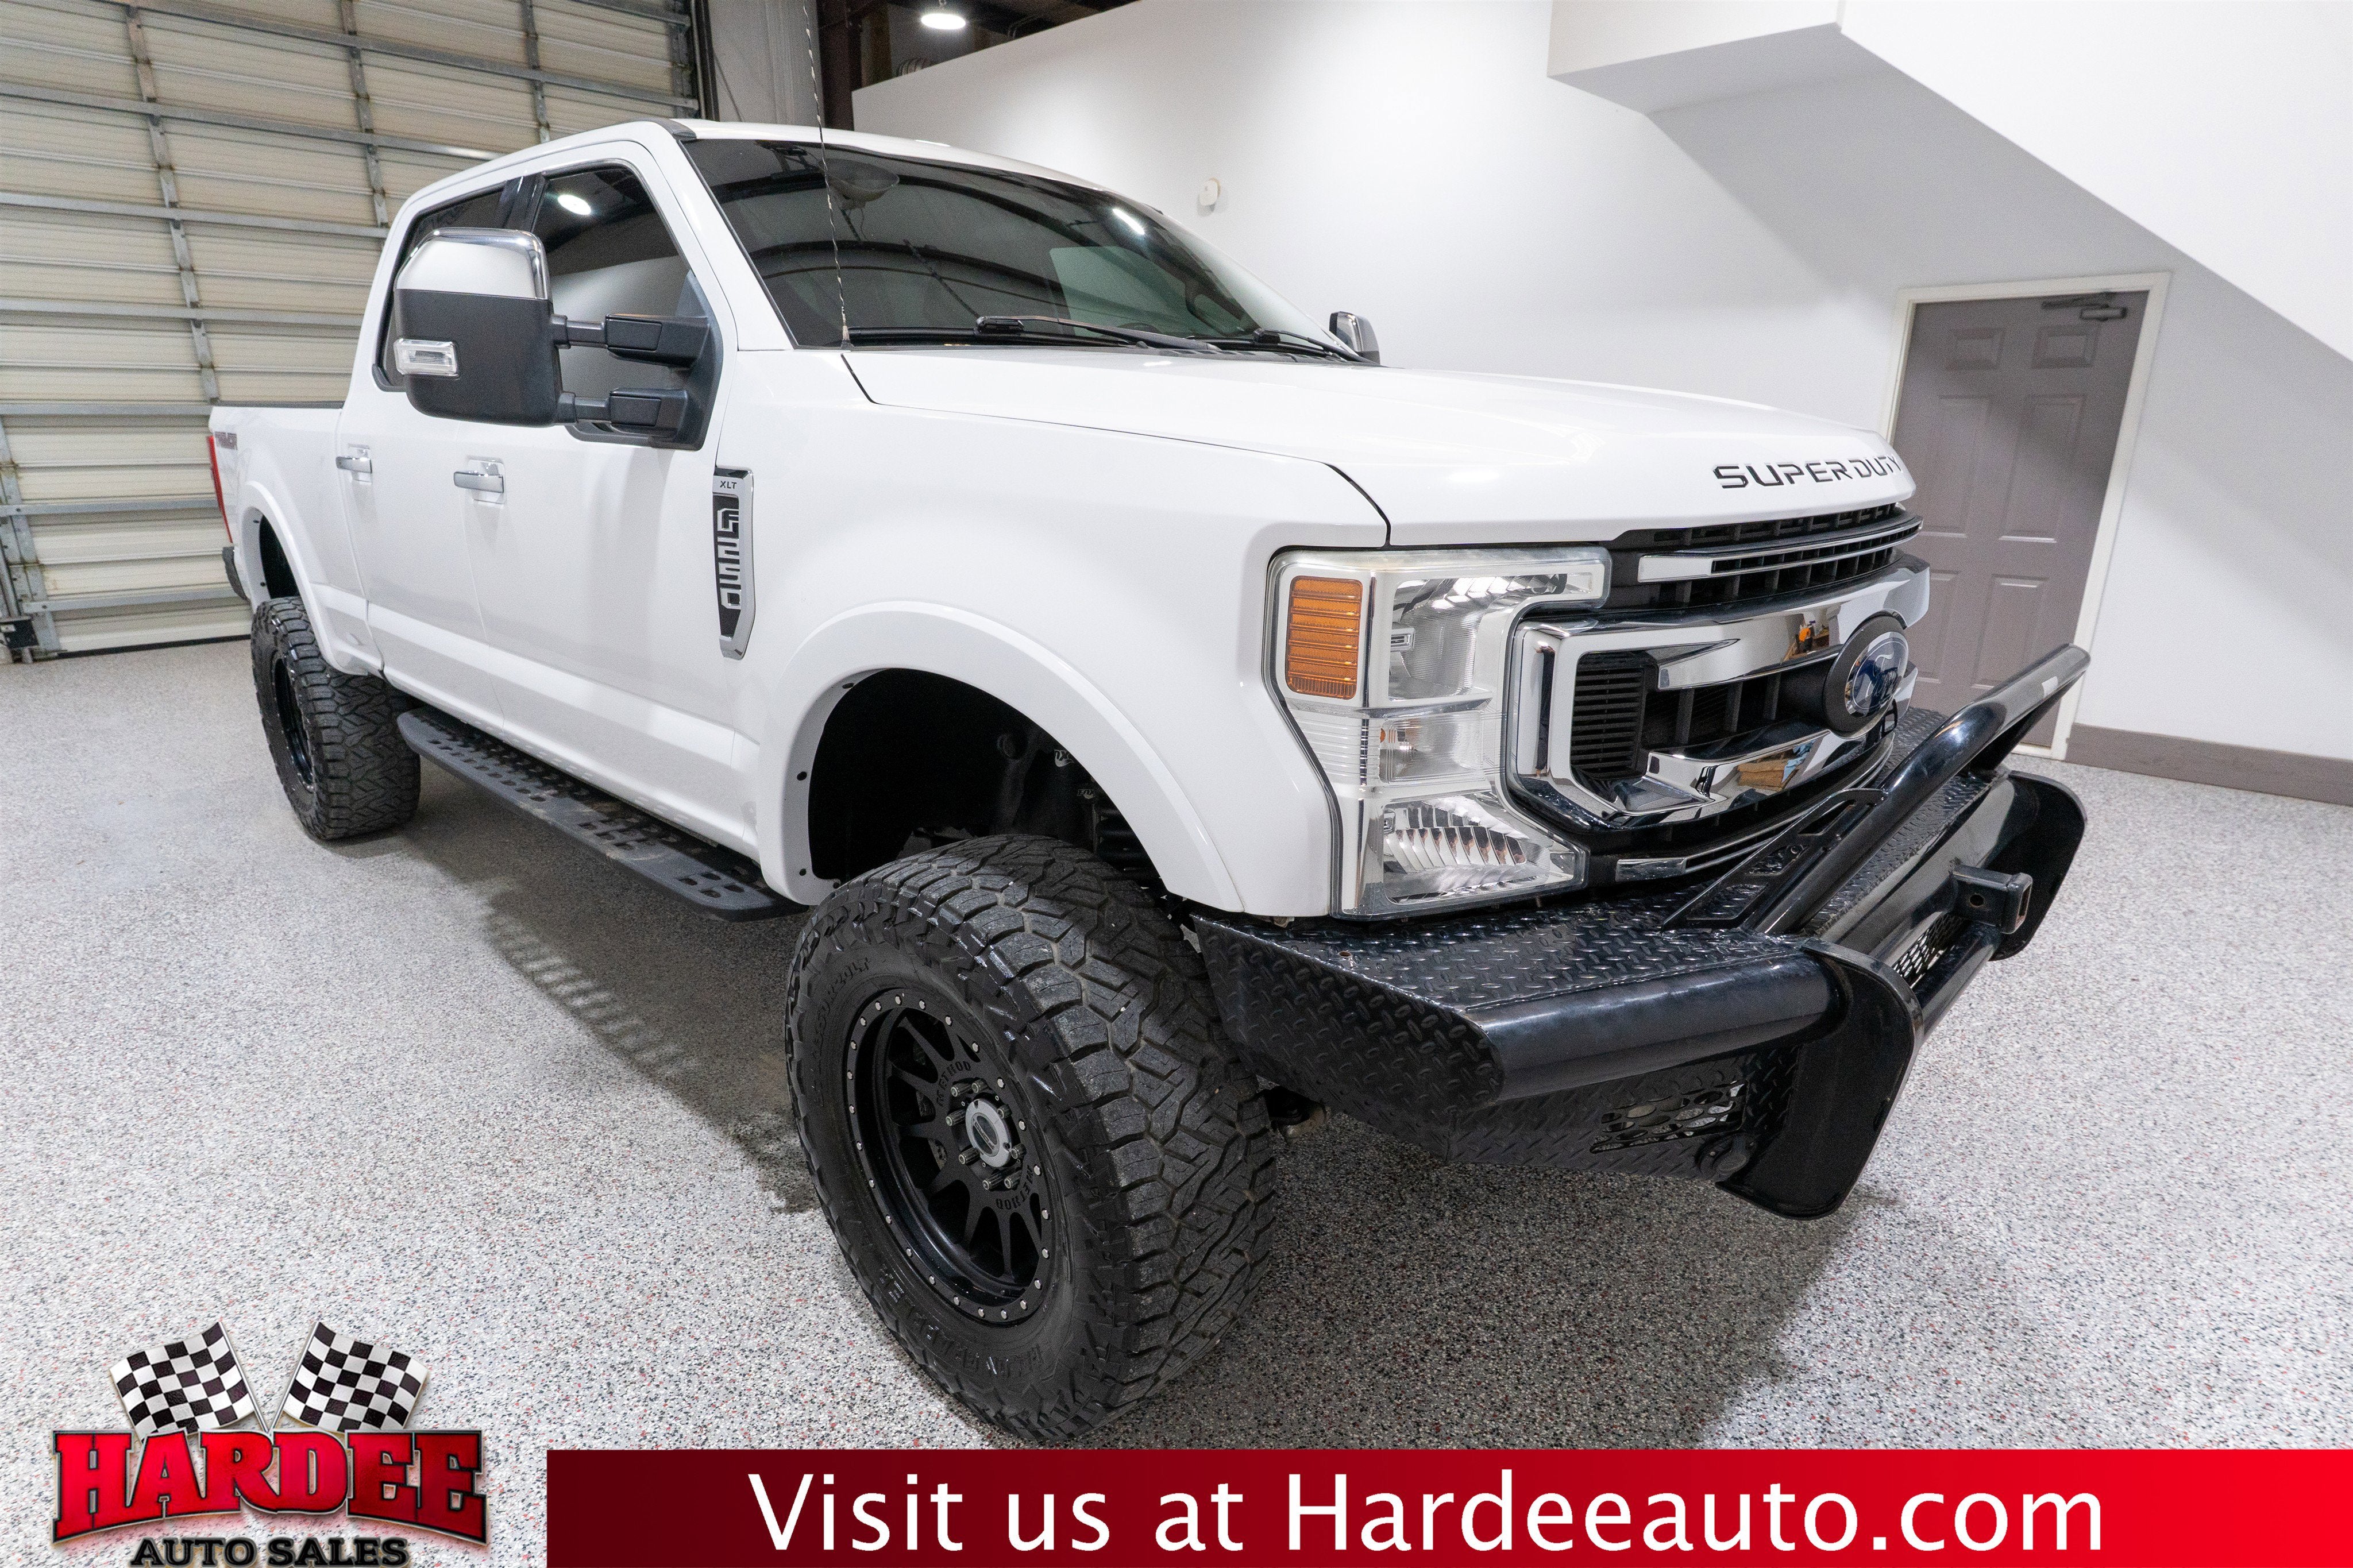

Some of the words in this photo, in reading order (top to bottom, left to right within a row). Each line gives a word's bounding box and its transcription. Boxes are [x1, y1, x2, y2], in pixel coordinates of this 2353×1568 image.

[720, 480, 737, 489] XLT
[1712, 460, 1853, 489] SUPER
[1848, 455, 1902, 478] DUTY
[936, 1060, 971, 1107] METHOD
[996, 1164, 1033, 1210] METHOD
